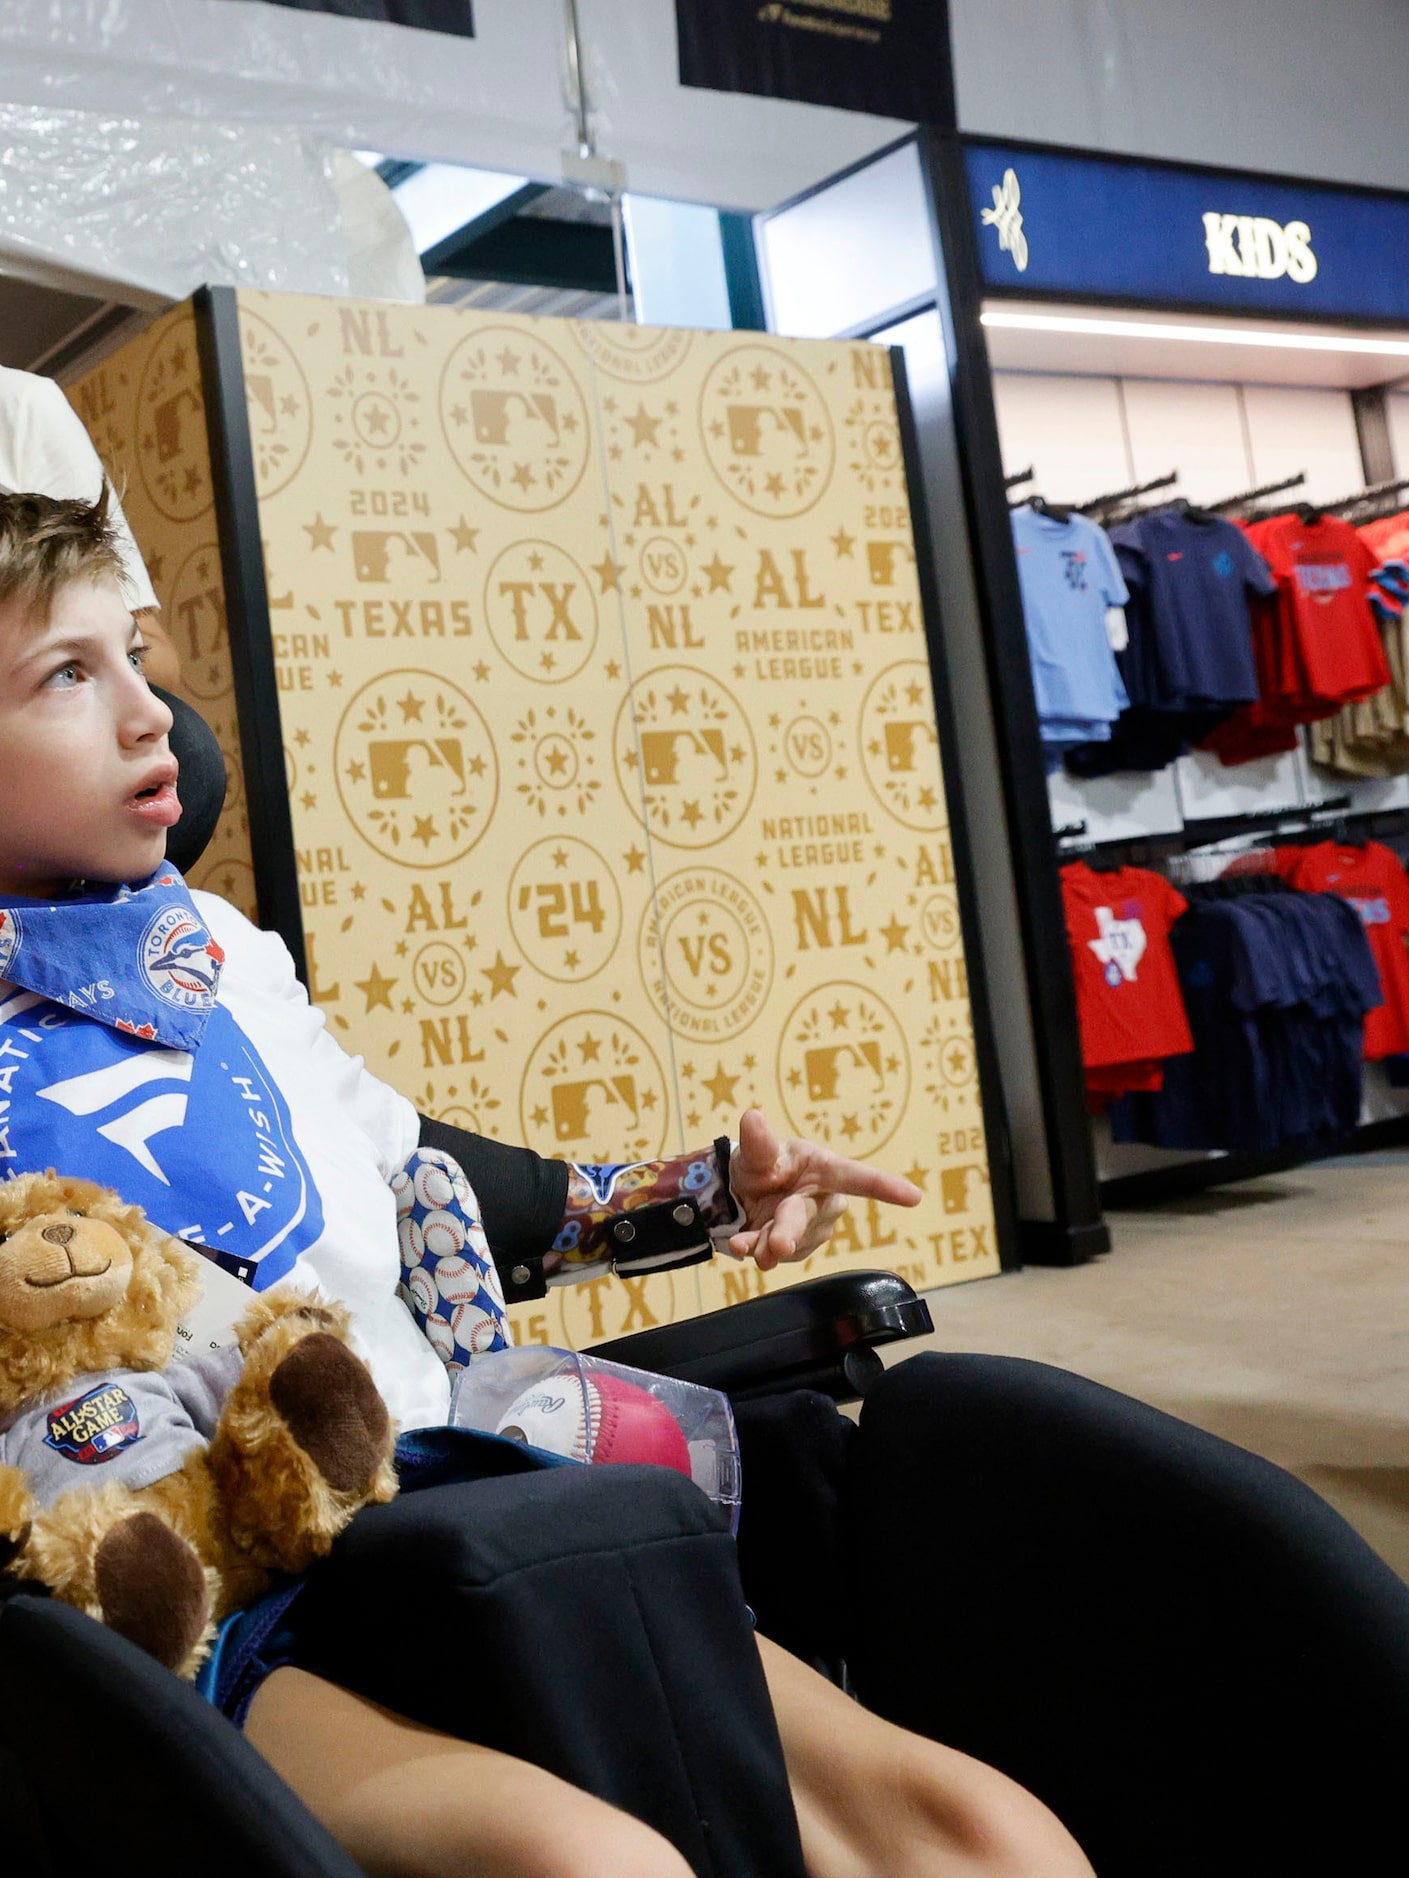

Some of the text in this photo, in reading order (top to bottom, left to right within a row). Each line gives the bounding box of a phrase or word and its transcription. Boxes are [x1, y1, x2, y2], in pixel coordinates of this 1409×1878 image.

[1202, 211, 1318, 284] KIDS
[339, 308, 404, 358] NL
[349, 490, 431, 517] 2024
[633, 482, 689, 528] AL
[647, 552, 680, 580] VS
[753, 548, 826, 609] AL
[335, 600, 474, 637] TEXAS
[499, 581, 583, 642] TX
[647, 604, 705, 649] NL
[855, 601, 924, 634] TEX
[735, 629, 854, 653] AMERICAN
[755, 656, 843, 681] LEAGUE
[792, 732, 824, 761] VS
[761, 812, 874, 841] NATIONAL
[777, 841, 866, 868] LEAGUE
[405, 881, 468, 933] AL
[791, 885, 868, 951] NL
[925, 911, 956, 936] VS
[678, 931, 733, 978] VS
[159, 979, 211, 1007] BLUE
[420, 960, 458, 989] VS
[56, 980, 115, 1008] AYS
[419, 1015, 485, 1069] NL
[576, 1273, 661, 1339] TX
[51, 1410, 85, 1441] ALL
[82, 1388, 128, 1418] STAR
[73, 1406, 124, 1443] GAME
